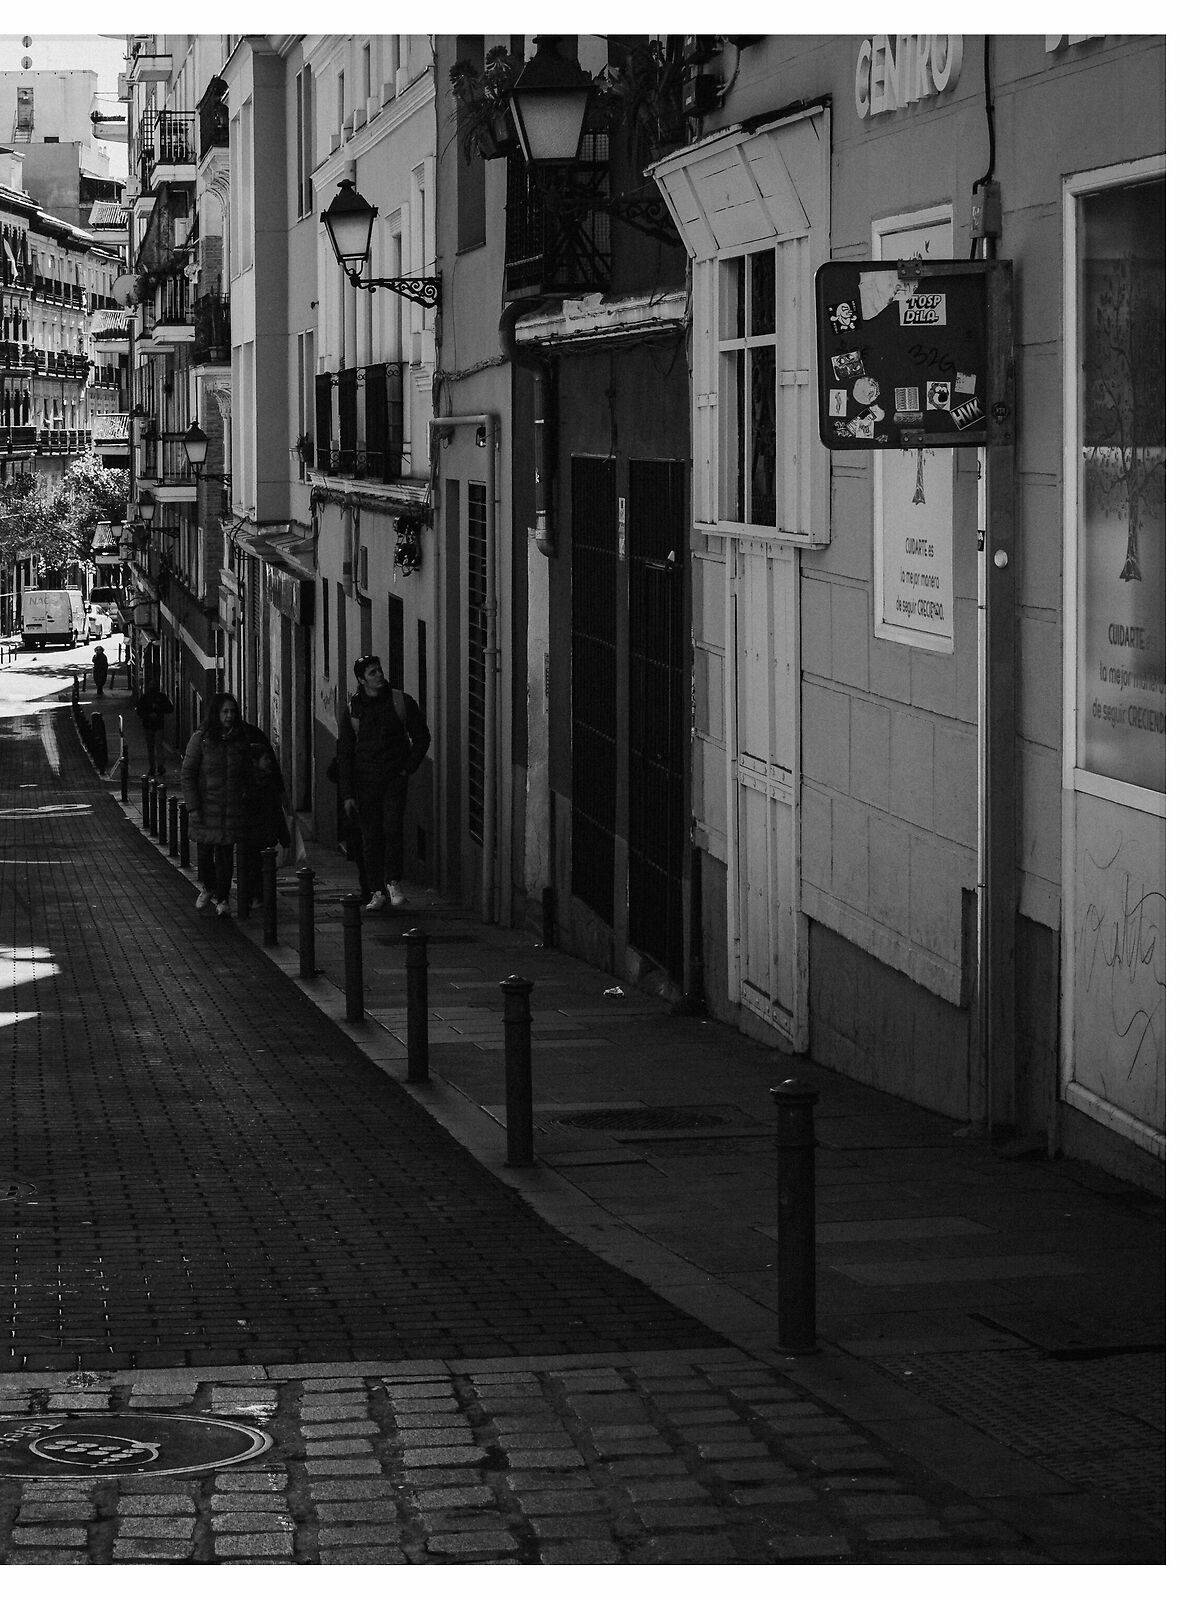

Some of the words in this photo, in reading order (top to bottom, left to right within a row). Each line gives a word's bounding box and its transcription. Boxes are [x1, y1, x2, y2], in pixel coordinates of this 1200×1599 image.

[855, 35, 963, 119] CENTRO
[909, 295, 942, 311] TOSP
[950, 398, 984, 428] HVK
[905, 537, 928, 556] CUIDARTE
[906, 570, 920, 589] mejor
[921, 573, 940, 589] manera
[902, 598, 917, 618] seguir
[1108, 623, 1145, 650] CUIDARTE
[1100, 660, 1107, 682] la
[1109, 664, 1131, 692] mejor
[1093, 697, 1101, 719] de
[1103, 702, 1127, 729] seguir
[1128, 704, 1166, 734] CRECIEND
